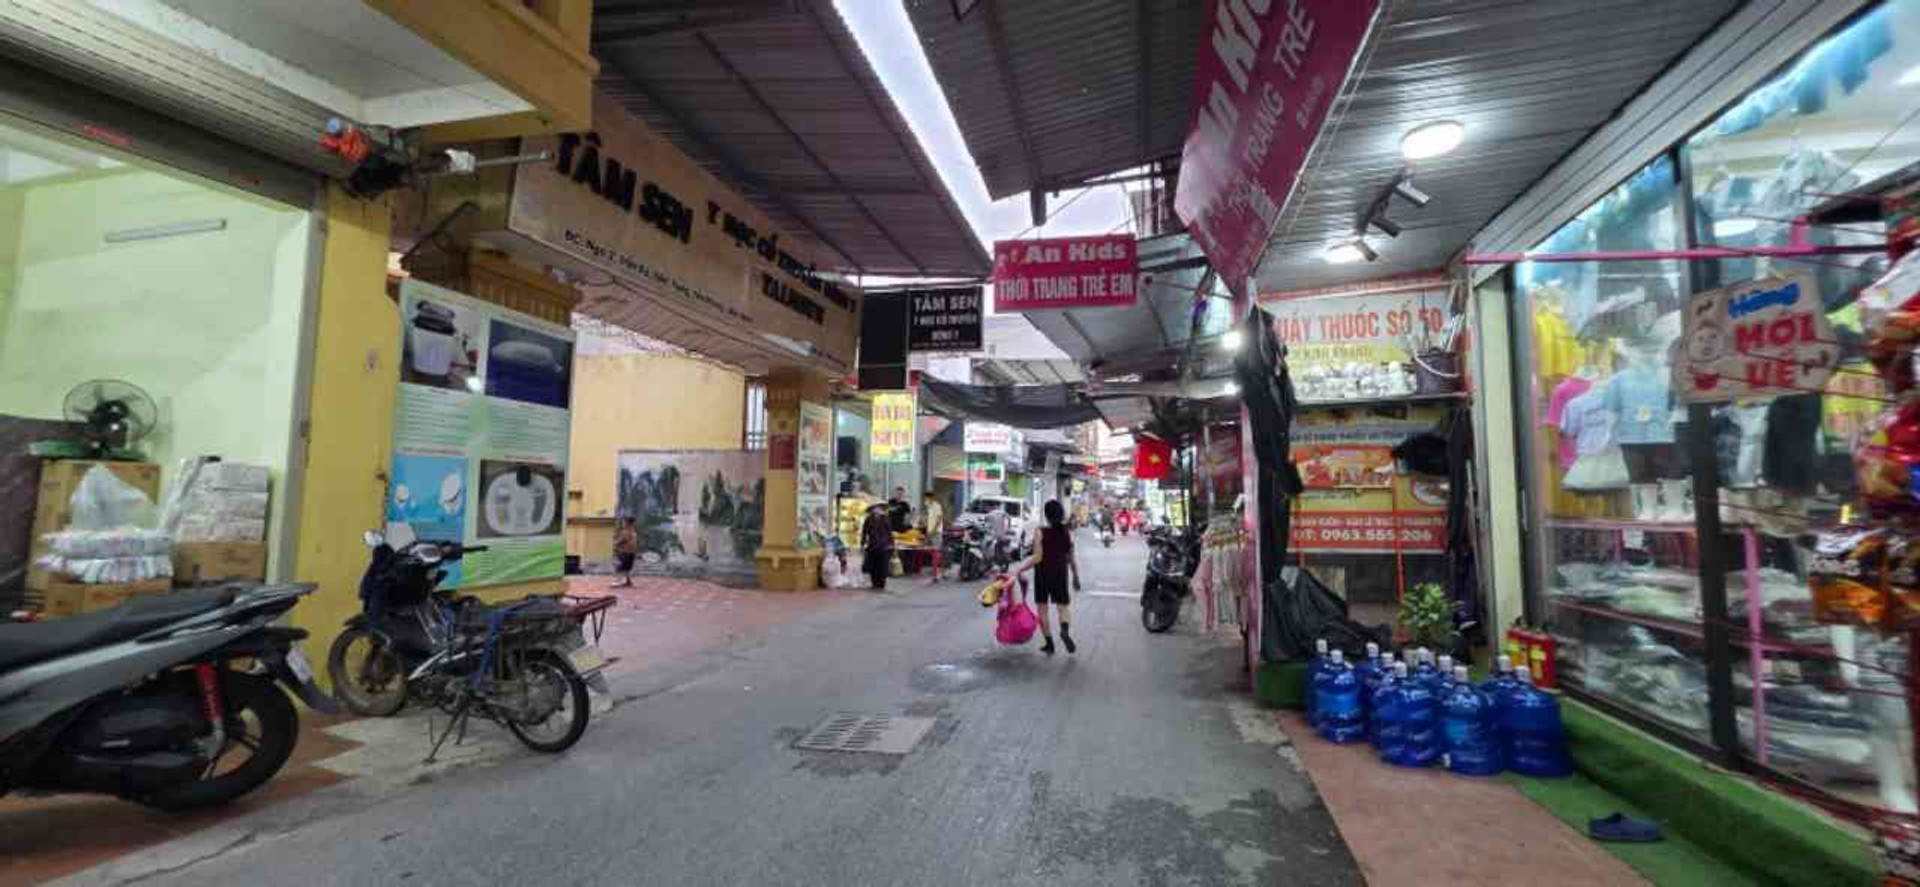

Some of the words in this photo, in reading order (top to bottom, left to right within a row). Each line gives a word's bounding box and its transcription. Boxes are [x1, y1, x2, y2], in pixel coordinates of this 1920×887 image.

[556, 132, 637, 214] TÂM
[639, 182, 694, 245] SEN
[1067, 241, 1129, 261] Kids
[1033, 275, 1078, 300] TRANG
[1111, 272, 1134, 296] EM
[914, 293, 946, 312] TÂM
[949, 294, 978, 310] SEN
[1319, 302, 1380, 341] THUỐC
[1321, 528, 1432, 542] 0963.555206
